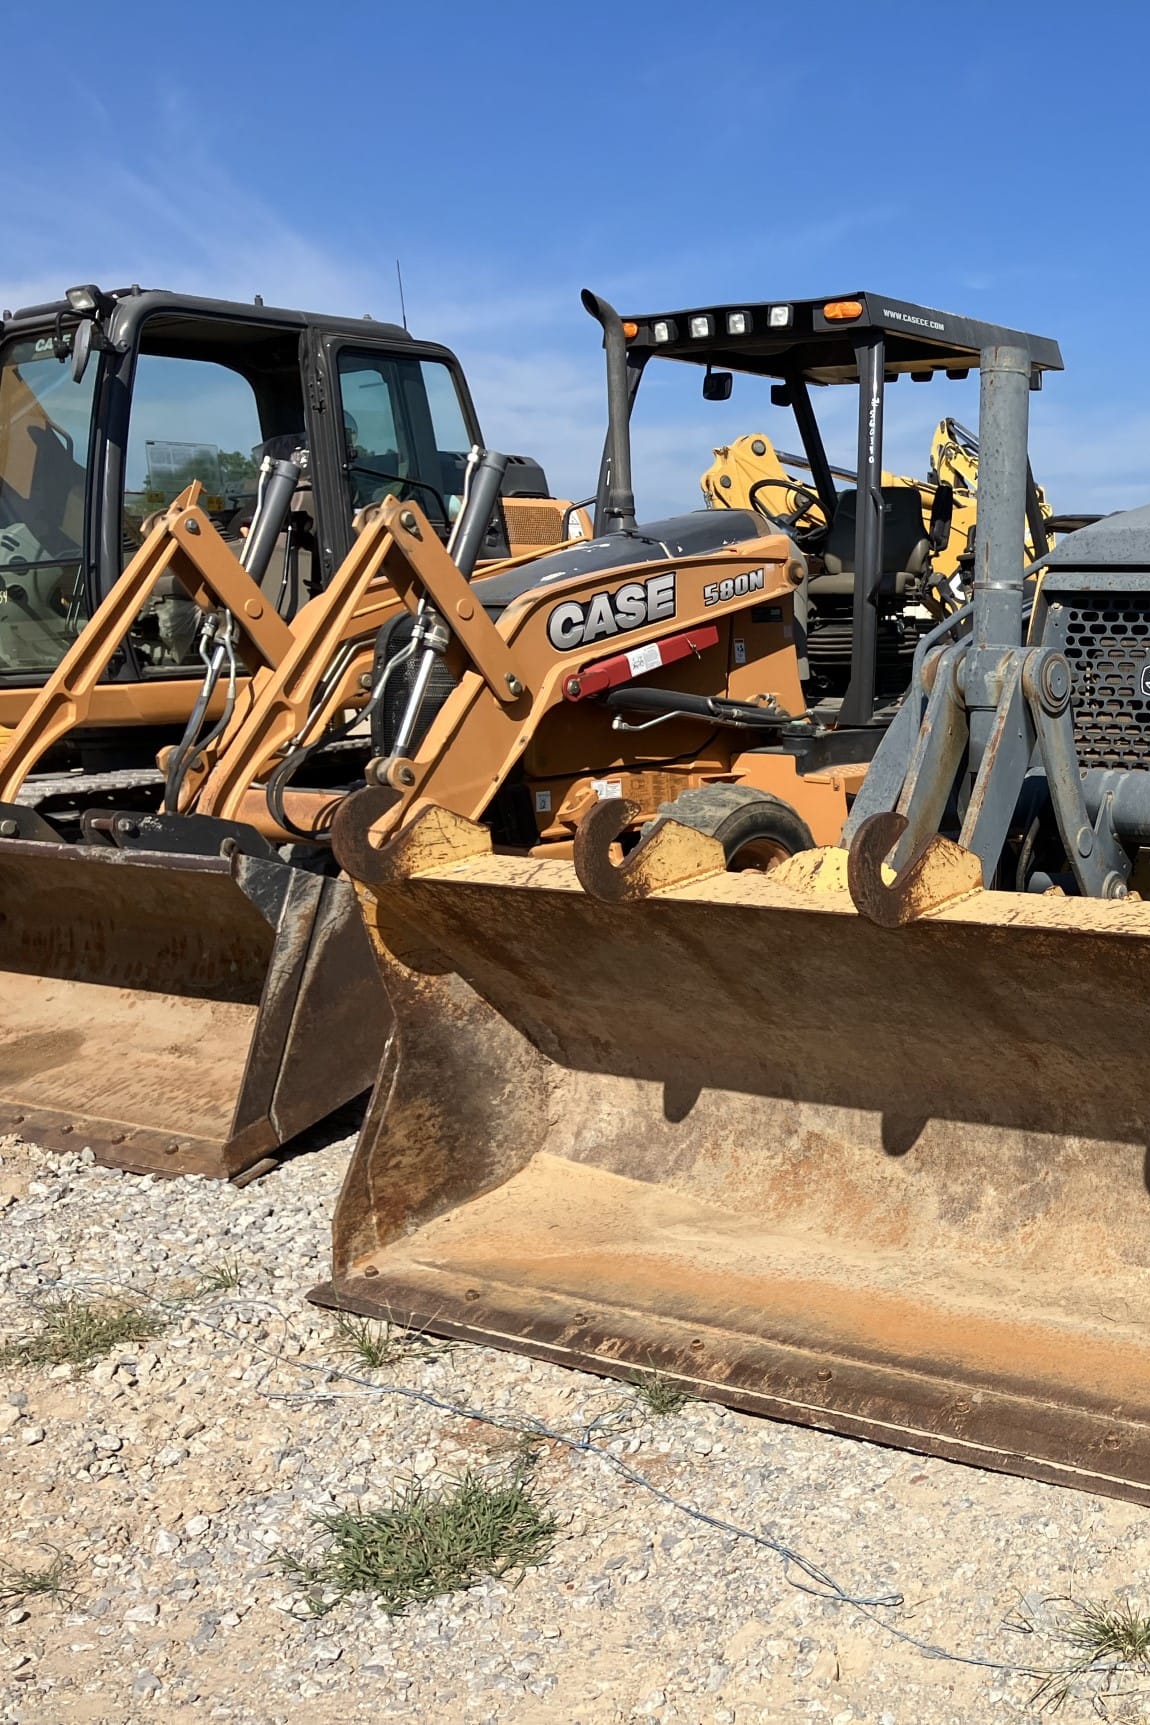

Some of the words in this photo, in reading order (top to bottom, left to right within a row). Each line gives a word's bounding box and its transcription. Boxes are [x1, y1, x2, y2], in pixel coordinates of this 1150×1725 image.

[883, 309, 945, 331] WWW.CASECE.COM
[35, 334, 72, 352] CAE
[703, 568, 765, 606] 580N
[549, 572, 676, 651] CASE
